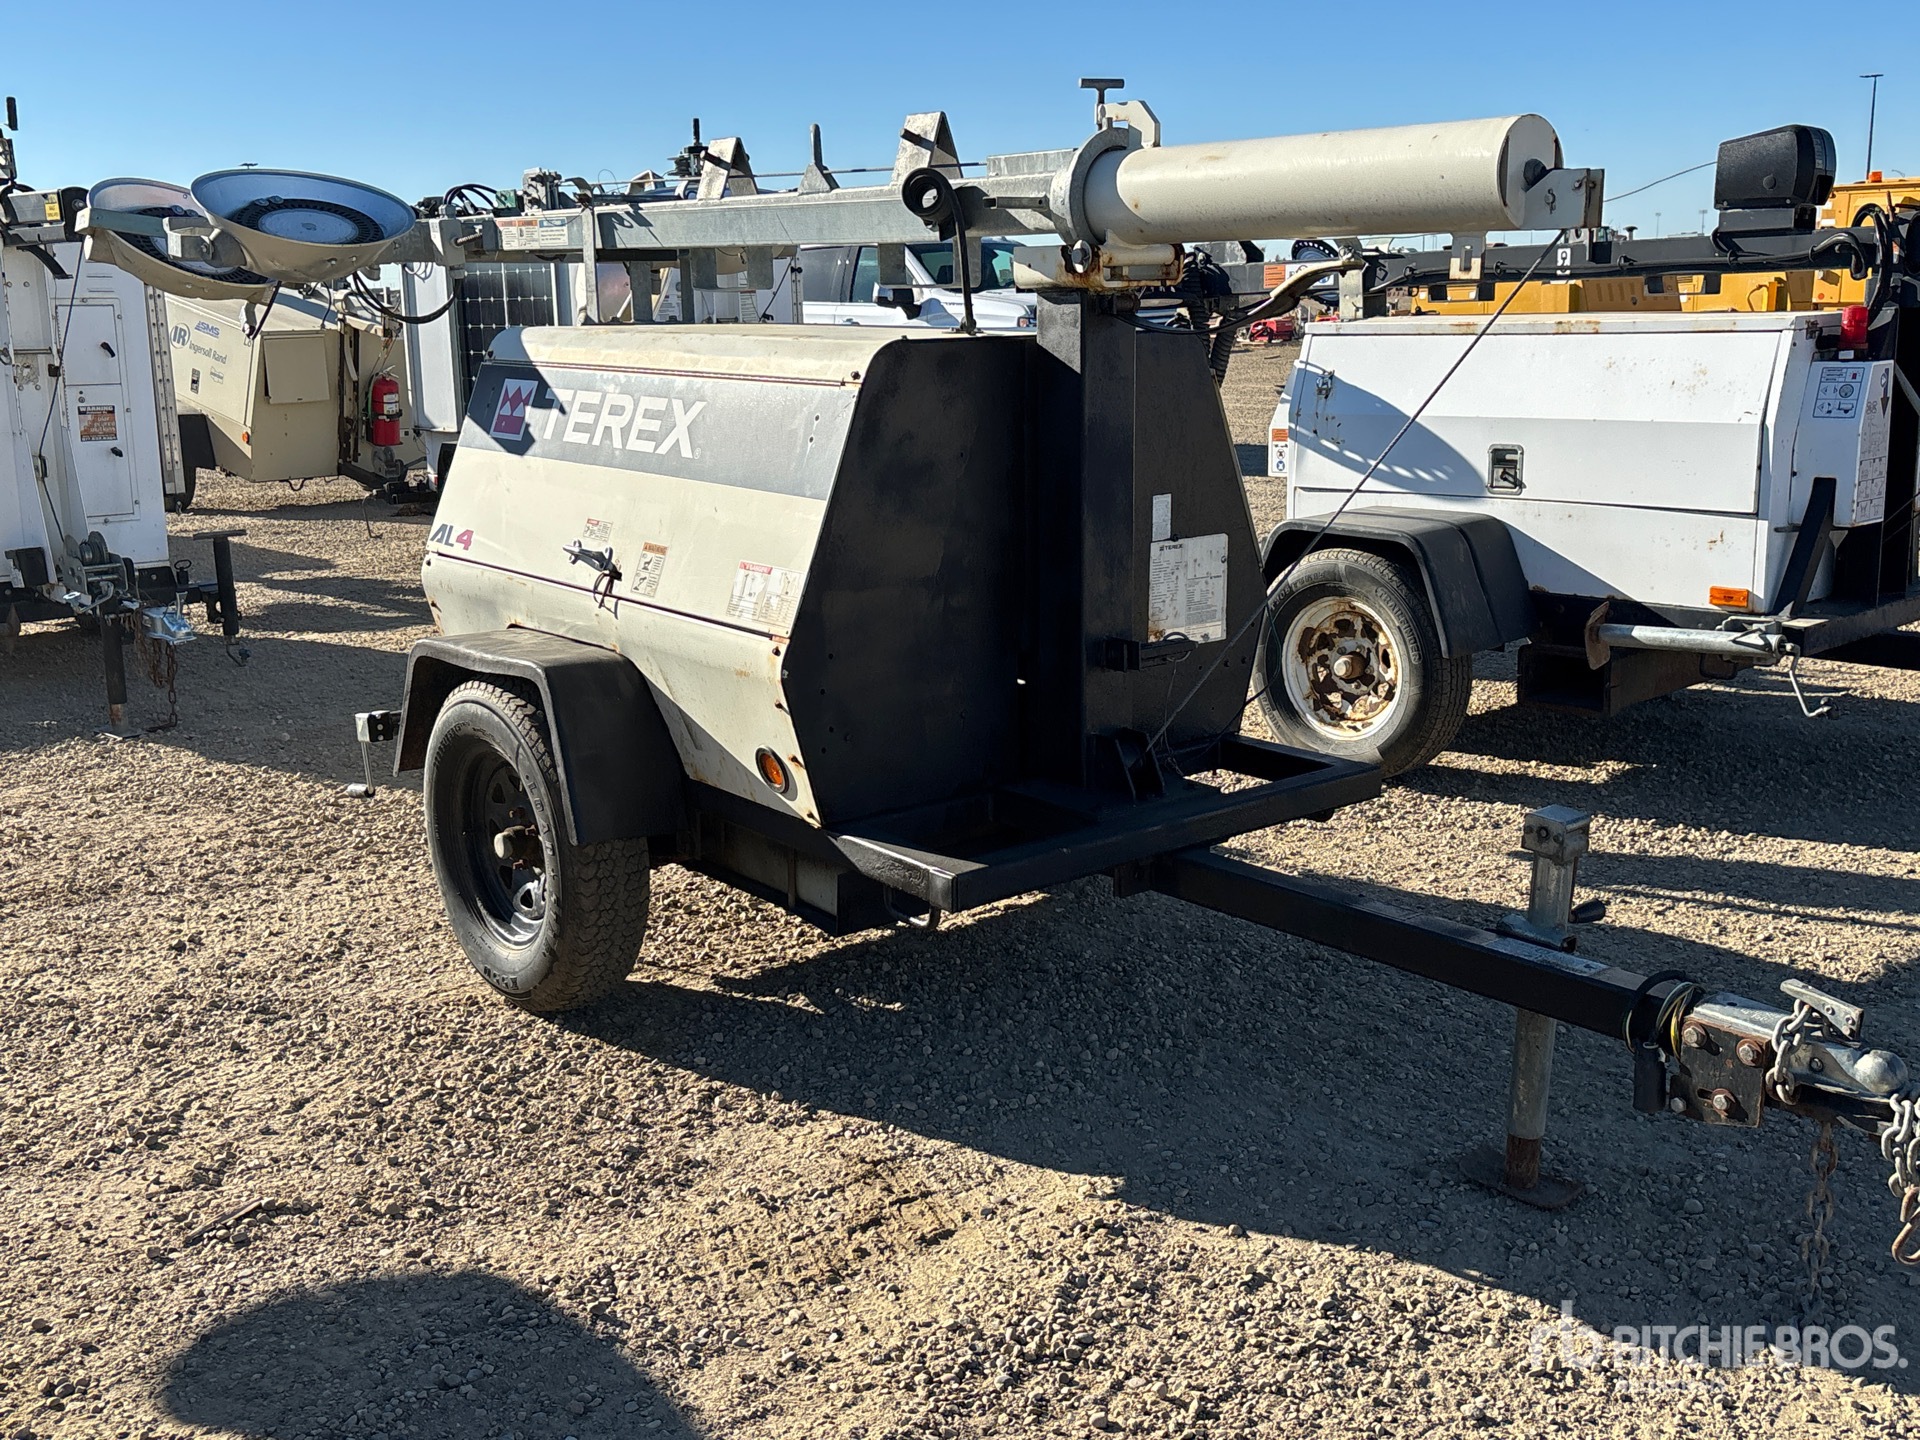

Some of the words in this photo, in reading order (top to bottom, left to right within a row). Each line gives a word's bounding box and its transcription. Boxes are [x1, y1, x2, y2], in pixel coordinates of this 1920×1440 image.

[173, 326, 187, 346] IR
[189, 341, 212, 358] Ingersoll
[212, 350, 228, 364] Rand
[543, 388, 707, 459] TEREX
